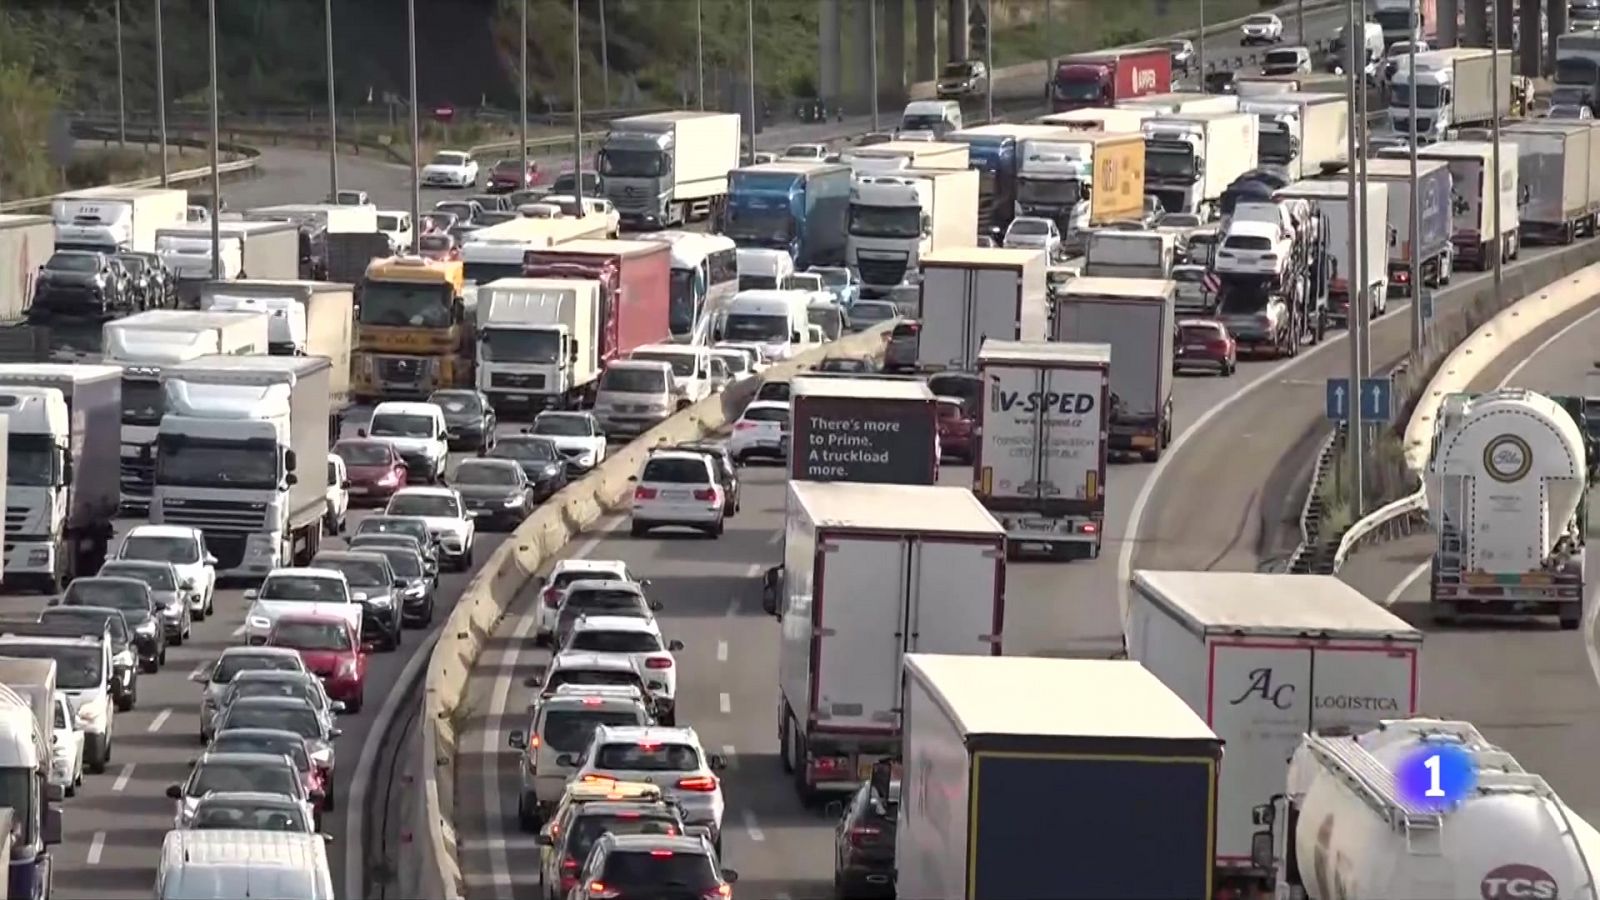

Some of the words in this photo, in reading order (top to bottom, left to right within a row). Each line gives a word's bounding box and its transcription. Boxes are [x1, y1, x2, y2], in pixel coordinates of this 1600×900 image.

[1000, 391, 1094, 414] V-SPED
[809, 417, 860, 430] There's
[864, 421, 900, 432] more
[809, 434, 825, 446] to
[828, 433, 873, 446] Prime.
[808, 449, 819, 461] A
[823, 450, 889, 463] truckload
[808, 466, 848, 476] more.
[1315, 696, 1398, 711] LOGISTICA
[1483, 878, 1556, 899] TCS
